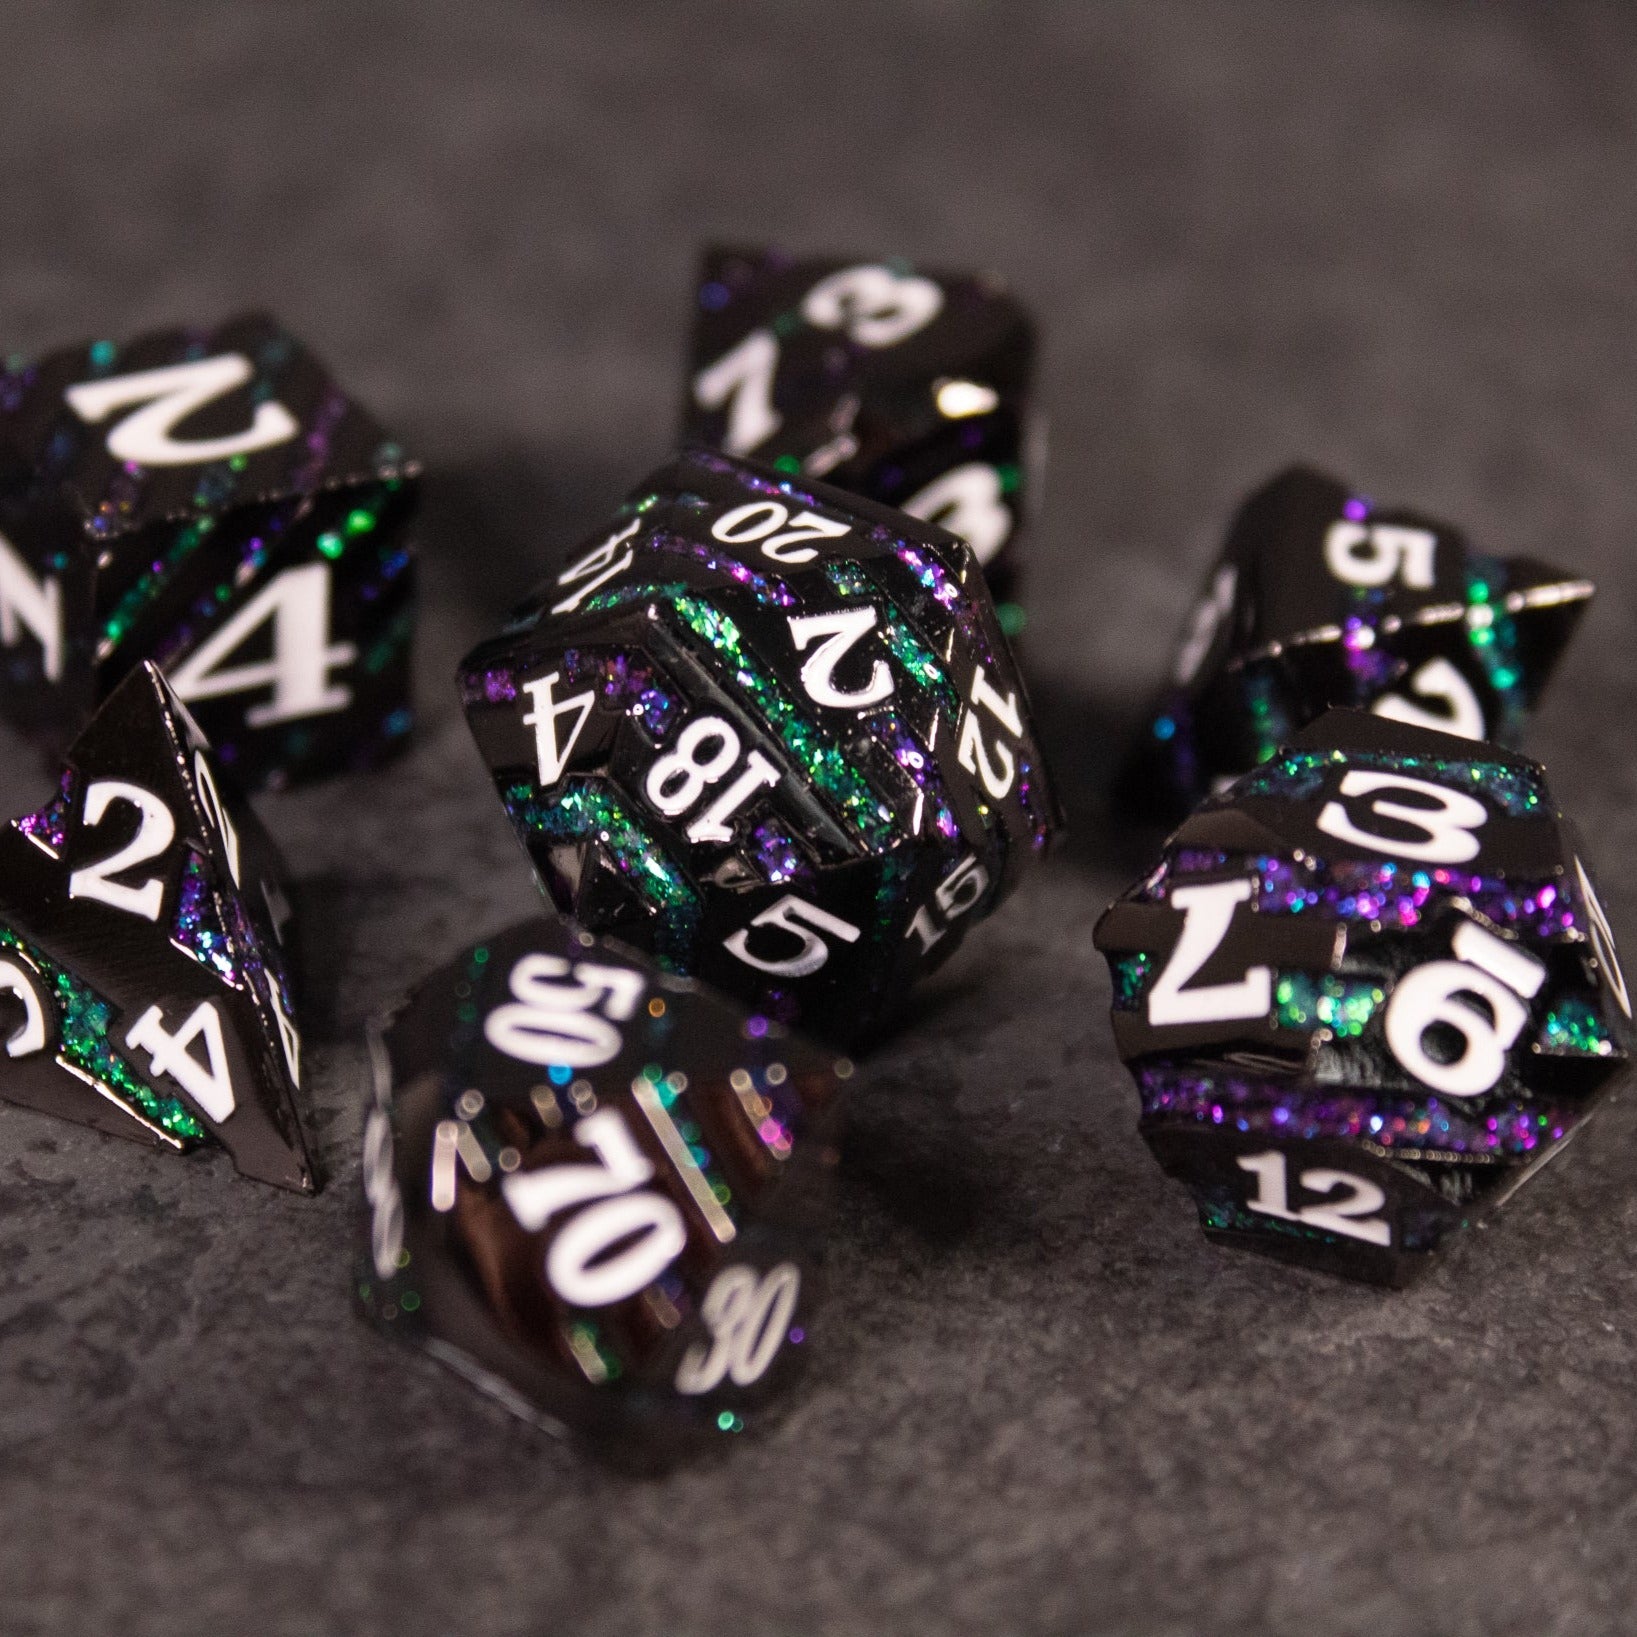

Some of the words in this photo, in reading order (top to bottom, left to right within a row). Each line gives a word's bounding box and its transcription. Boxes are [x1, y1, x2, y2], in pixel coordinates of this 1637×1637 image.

[66, 353, 297, 466] 2
[712, 502, 851, 563] 20
[1326, 521, 1437, 589] 5
[166, 562, 354, 724] 4
[787, 606, 894, 707] 2
[523, 672, 595, 785] 4
[647, 717, 780, 843] 18
[958, 665, 1022, 798] 12
[70, 782, 174, 921] 2
[1319, 771, 1486, 862] 3
[724, 896, 860, 975] 5
[905, 856, 986, 951] 15
[1149, 881, 1270, 1025] 7
[126, 1002, 234, 1122] 4
[484, 952, 645, 1070] 50
[503, 1107, 687, 1306] 70
[1236, 1150, 1391, 1247] 12
